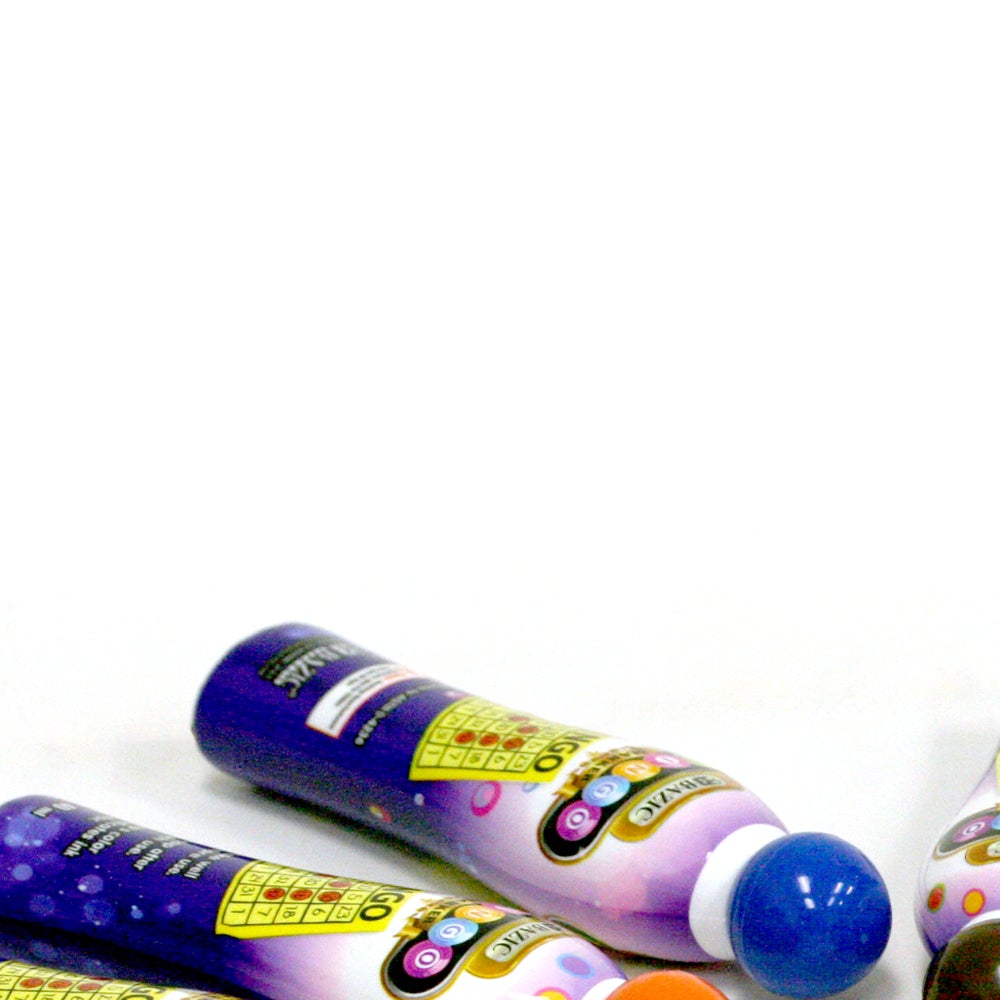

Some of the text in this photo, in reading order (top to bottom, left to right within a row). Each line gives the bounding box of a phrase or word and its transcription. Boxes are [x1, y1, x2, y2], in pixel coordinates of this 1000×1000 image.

[638, 777, 703, 823] BAZIC
[258, 908, 272, 916] 7
[282, 905, 295, 918] 18
[312, 905, 324, 916] 6
[336, 905, 353, 920] 23
